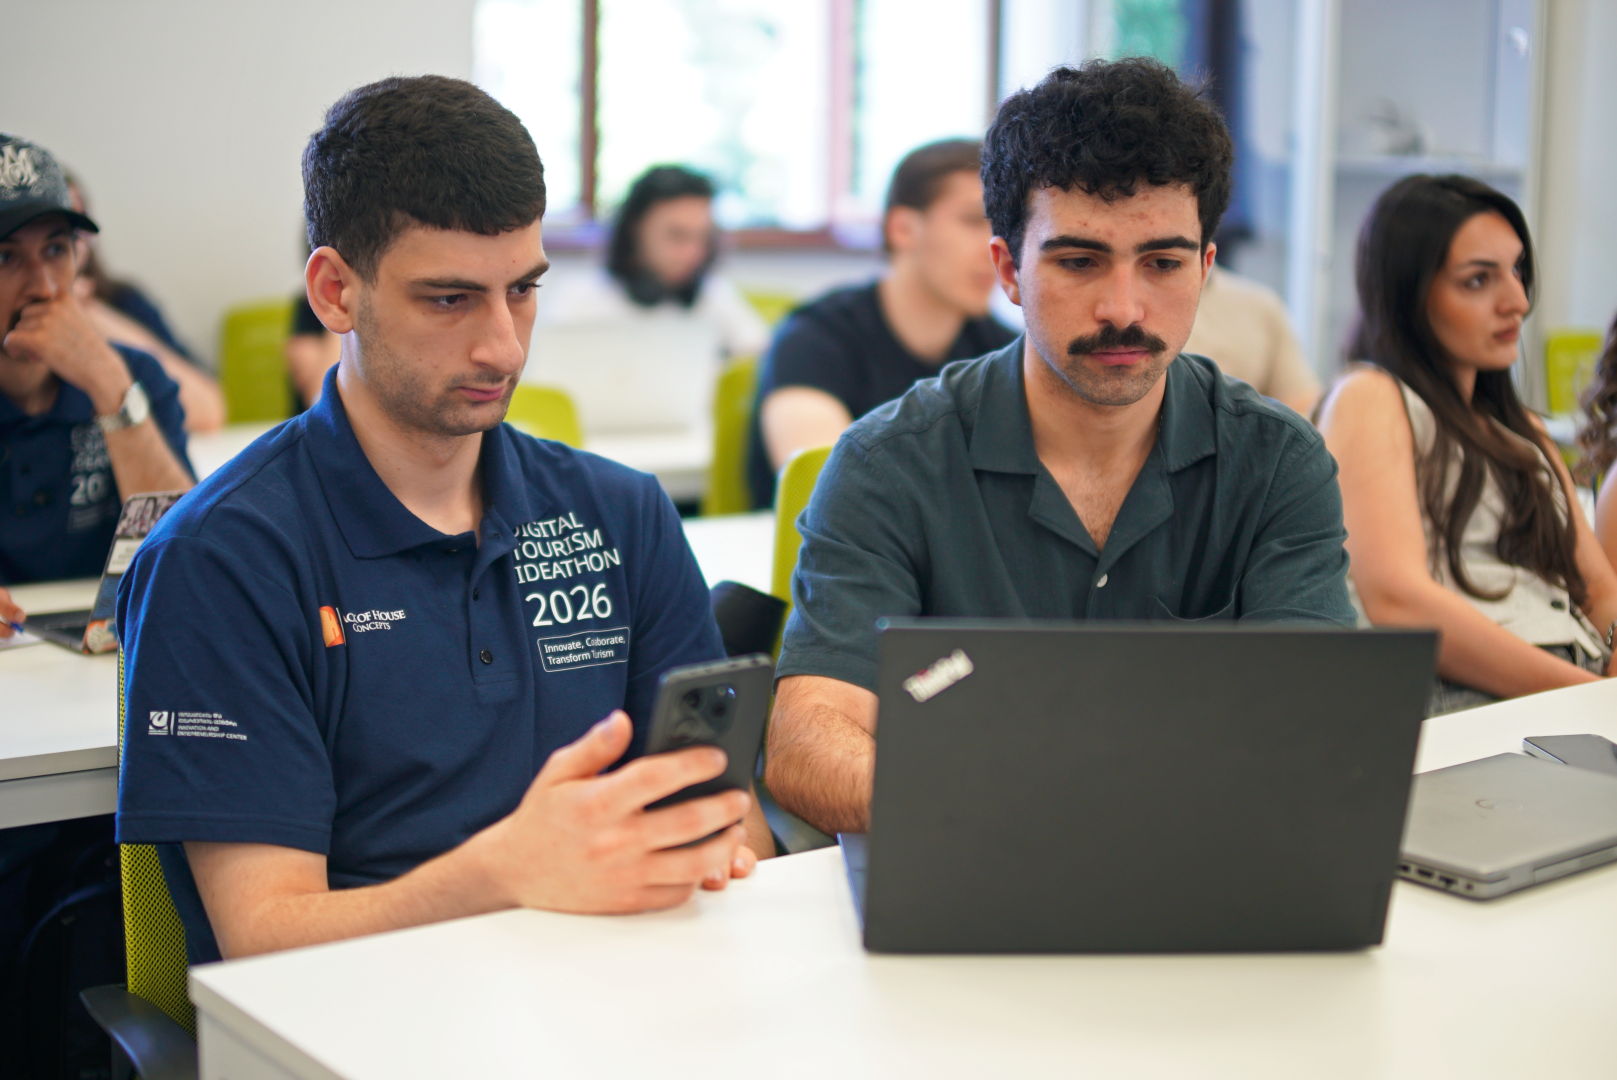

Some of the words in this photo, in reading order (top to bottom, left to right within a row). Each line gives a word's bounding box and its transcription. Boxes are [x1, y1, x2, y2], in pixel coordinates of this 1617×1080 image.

[514, 548, 621, 584] IDEATHON
[525, 583, 612, 627] 2026
[371, 609, 406, 622] HOUSE
[352, 621, 391, 633] CONCEPTS
[544, 640, 585, 654] Innovate,
[547, 651, 591, 666] Transform
